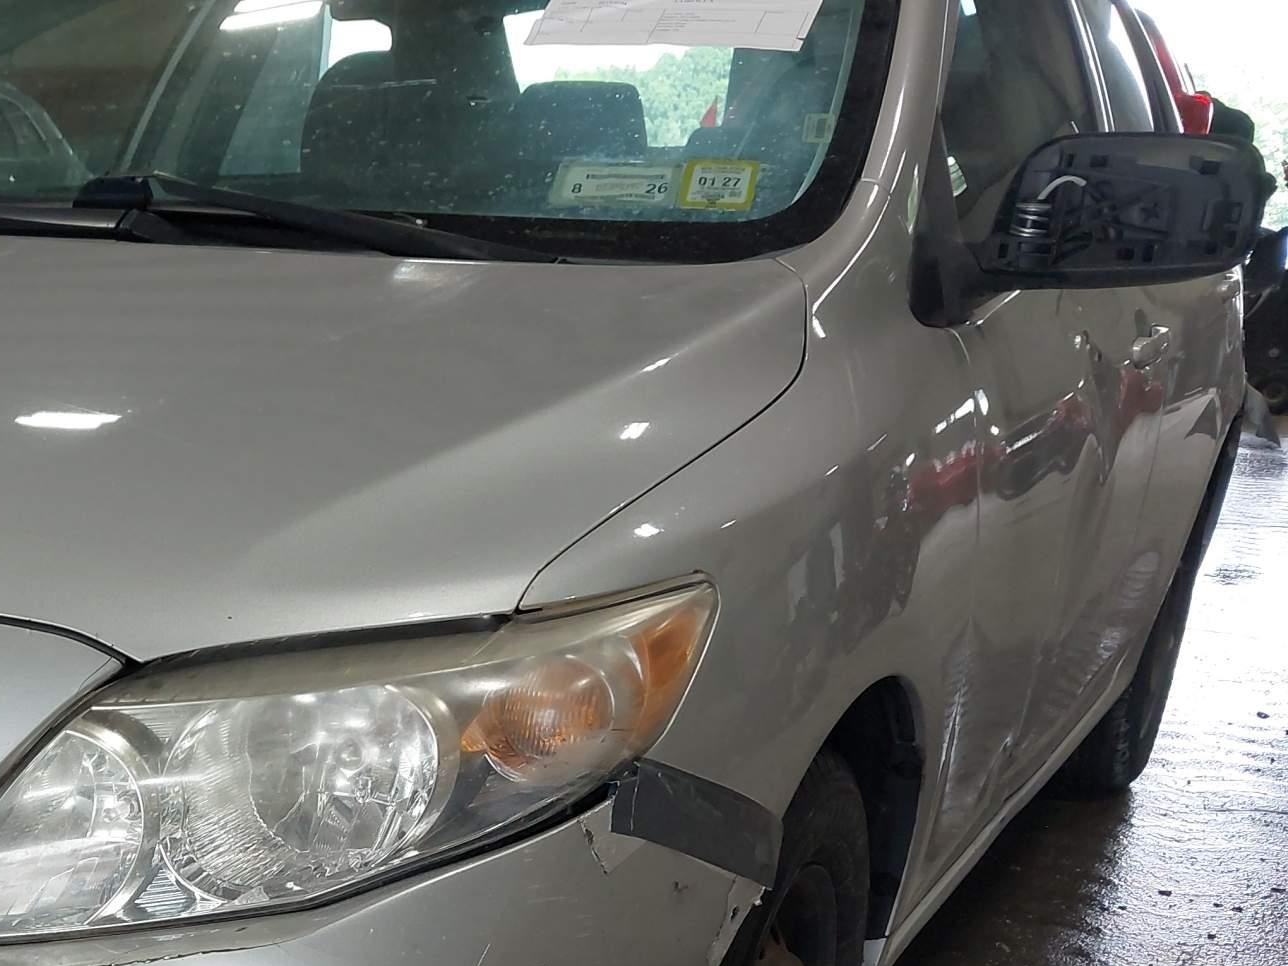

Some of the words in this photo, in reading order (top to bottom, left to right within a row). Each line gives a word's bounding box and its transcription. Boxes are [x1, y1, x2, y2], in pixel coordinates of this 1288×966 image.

[698, 176, 716, 187] 01
[722, 176, 741, 187] 27
[571, 183, 583, 194] 8
[645, 182, 669, 194] 26
